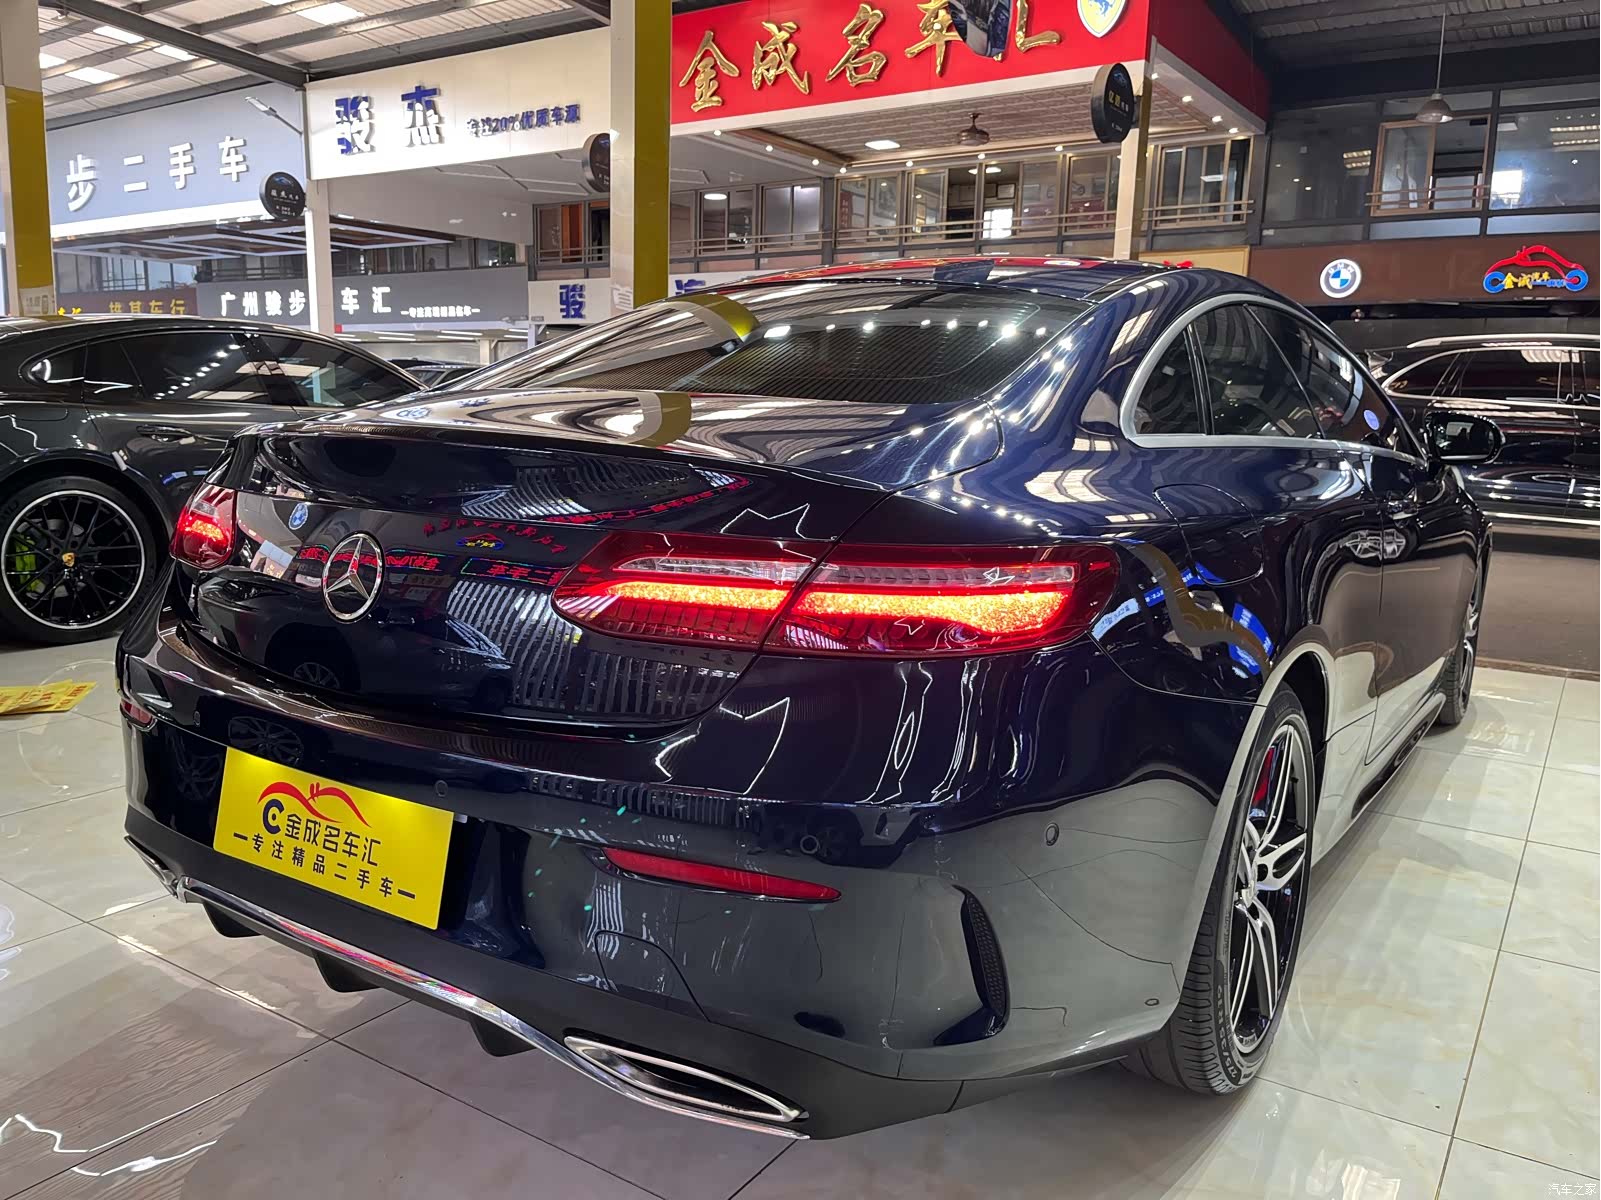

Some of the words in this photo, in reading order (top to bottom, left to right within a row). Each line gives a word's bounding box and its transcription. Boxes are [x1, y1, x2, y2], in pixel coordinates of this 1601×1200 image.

[335, 84, 446, 155] 骏杰
[284, 813, 382, 867] 金成名车汇
